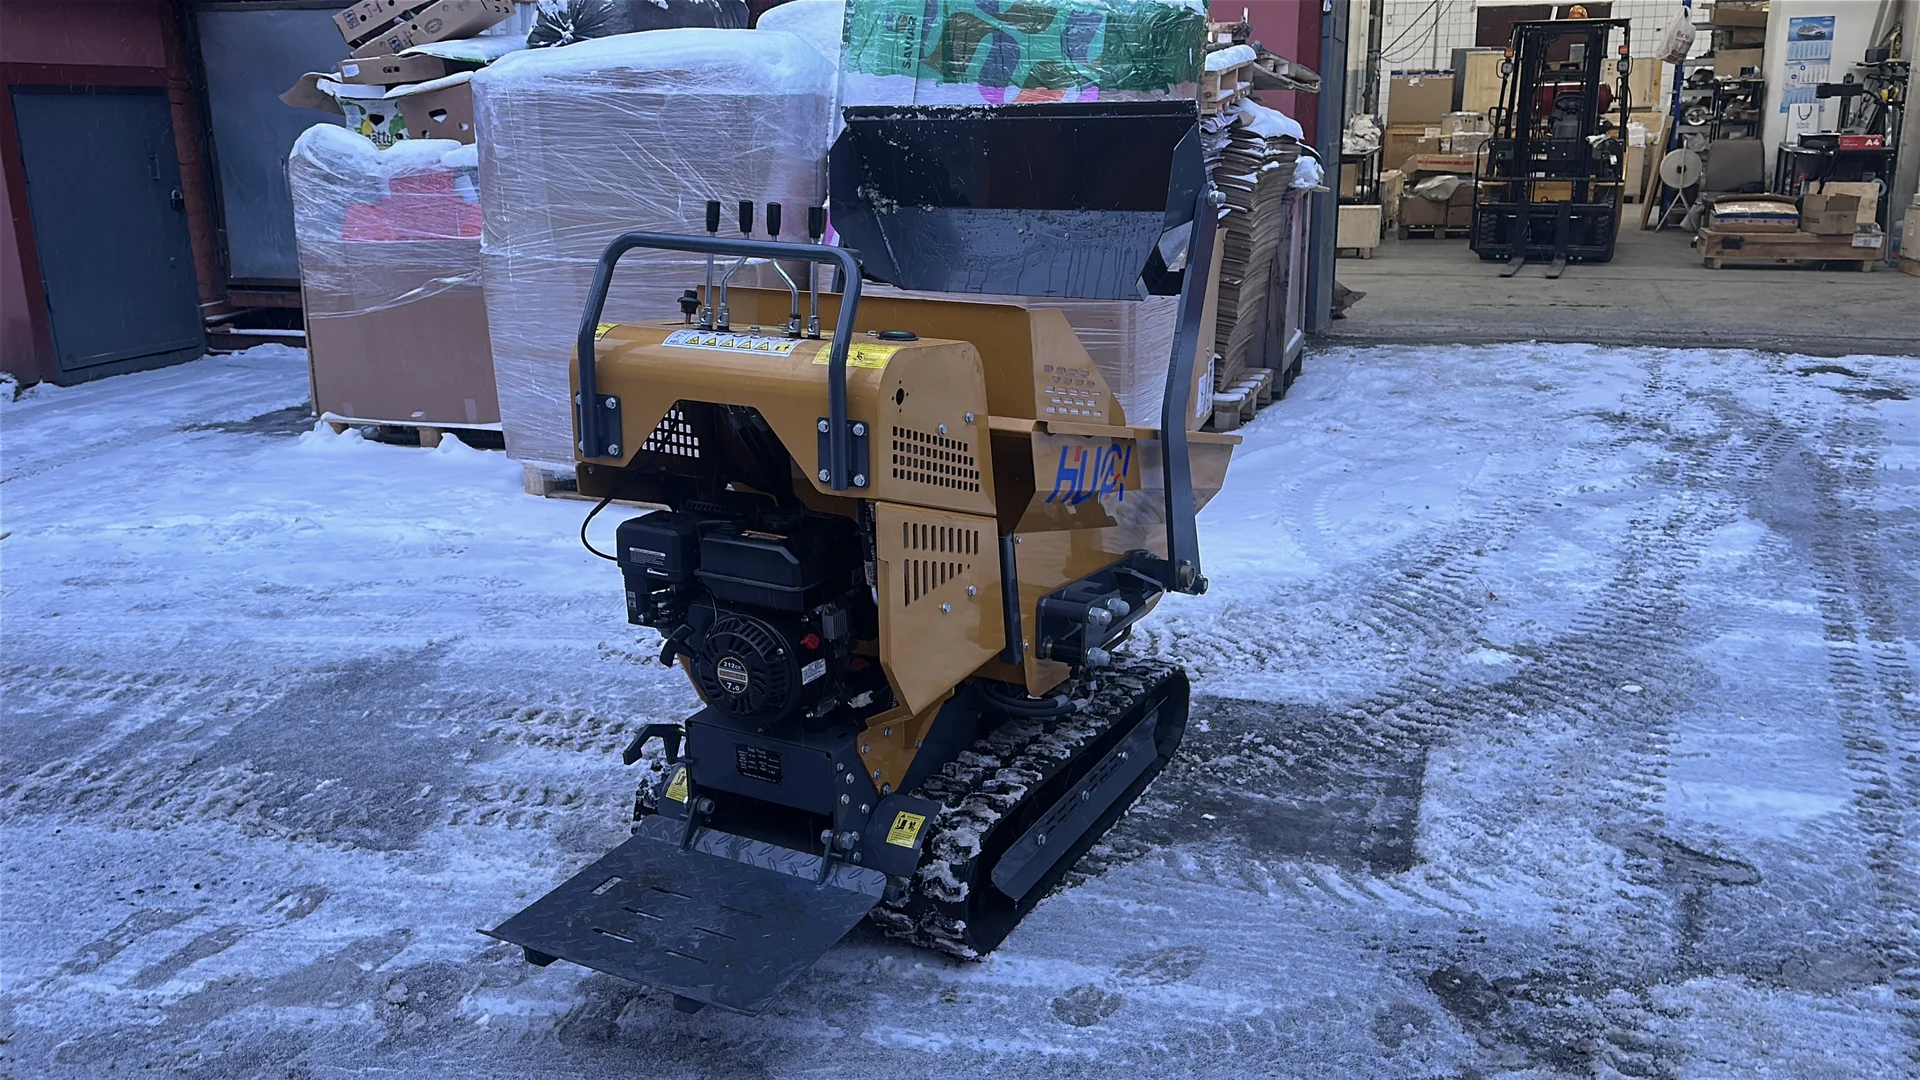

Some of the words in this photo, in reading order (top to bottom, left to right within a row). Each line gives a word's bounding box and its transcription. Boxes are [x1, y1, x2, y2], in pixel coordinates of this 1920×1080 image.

[1864, 138, 1880, 146] A4
[723, 661, 742, 670] 212cc
[726, 682, 740, 691] 7.0
